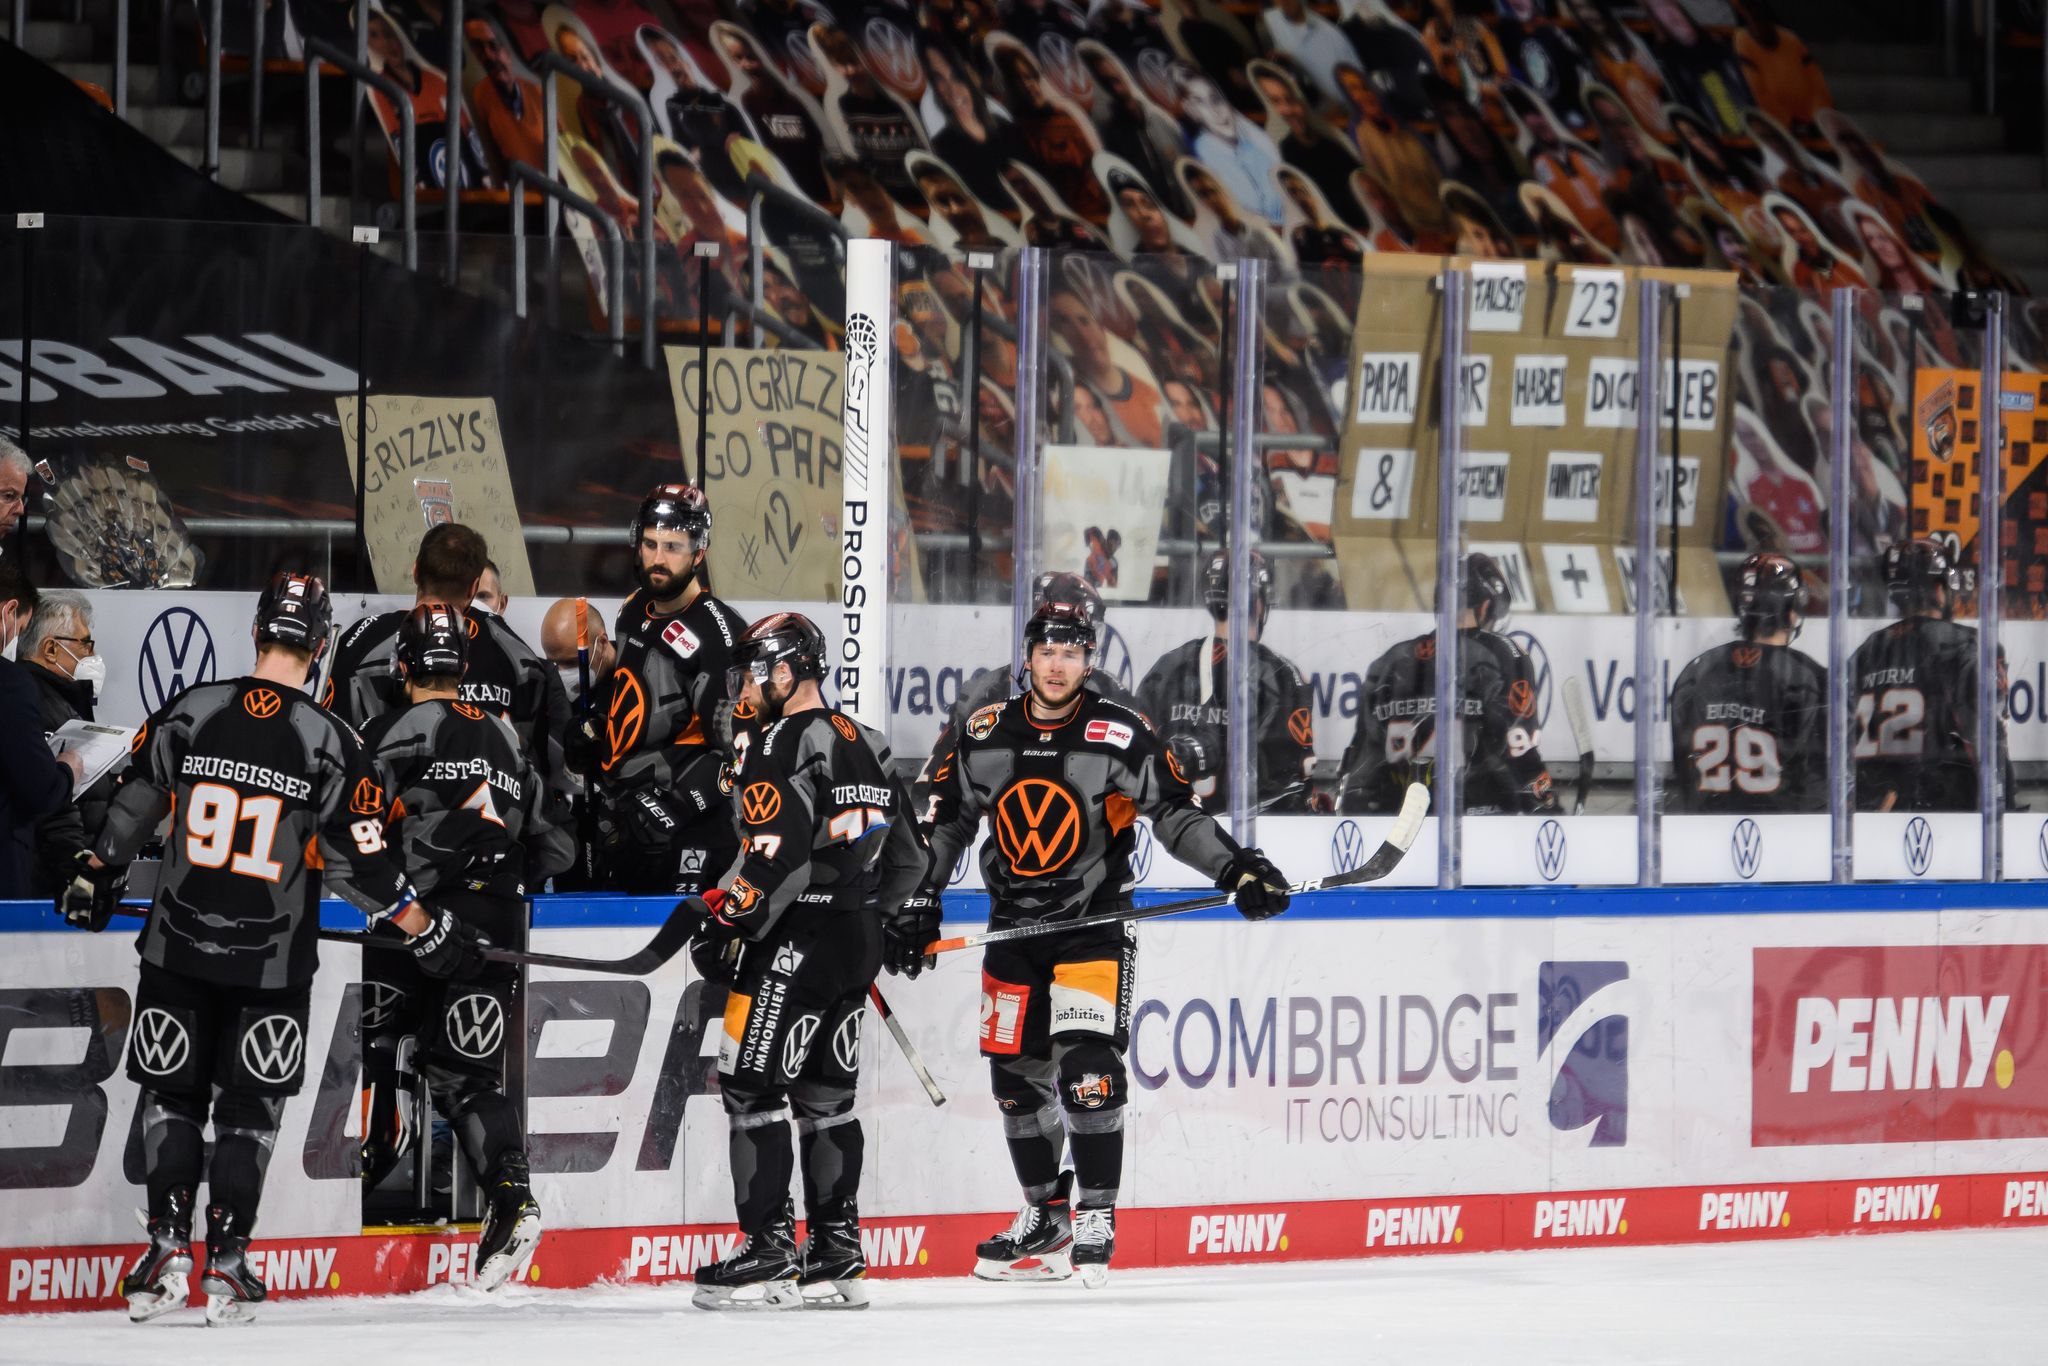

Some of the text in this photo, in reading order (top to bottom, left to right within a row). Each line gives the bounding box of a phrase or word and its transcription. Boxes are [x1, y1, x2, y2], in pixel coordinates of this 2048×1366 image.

[1577, 282, 1618, 327] 23
[681, 354, 844, 425] GO GRIZZ
[205, 414, 312, 433] GmbH
[364, 410, 486, 494] GRIZZLYS
[697, 422, 843, 488] GO PAP
[1369, 454, 1394, 511] &
[704, 600, 733, 648] peakzone
[841, 500, 868, 714] PROSPORT
[458, 684, 511, 707] KARD
[1706, 703, 1766, 724] BUSCH
[1854, 688, 1926, 758] 12
[181, 755, 312, 801] BRUGGISSER
[1693, 724, 1783, 794] 29
[186, 782, 284, 884] 91
[742, 979, 772, 1069] VOLKSWAGEN
[996, 991, 1021, 1002] RADIO
[1055, 1007, 1105, 1024] jobilities
[753, 982, 787, 1073] IMMOBILIEN
[1129, 992, 1518, 1091] COMBRIDGE
[1286, 1091, 1519, 1144] IT CONSULTING
